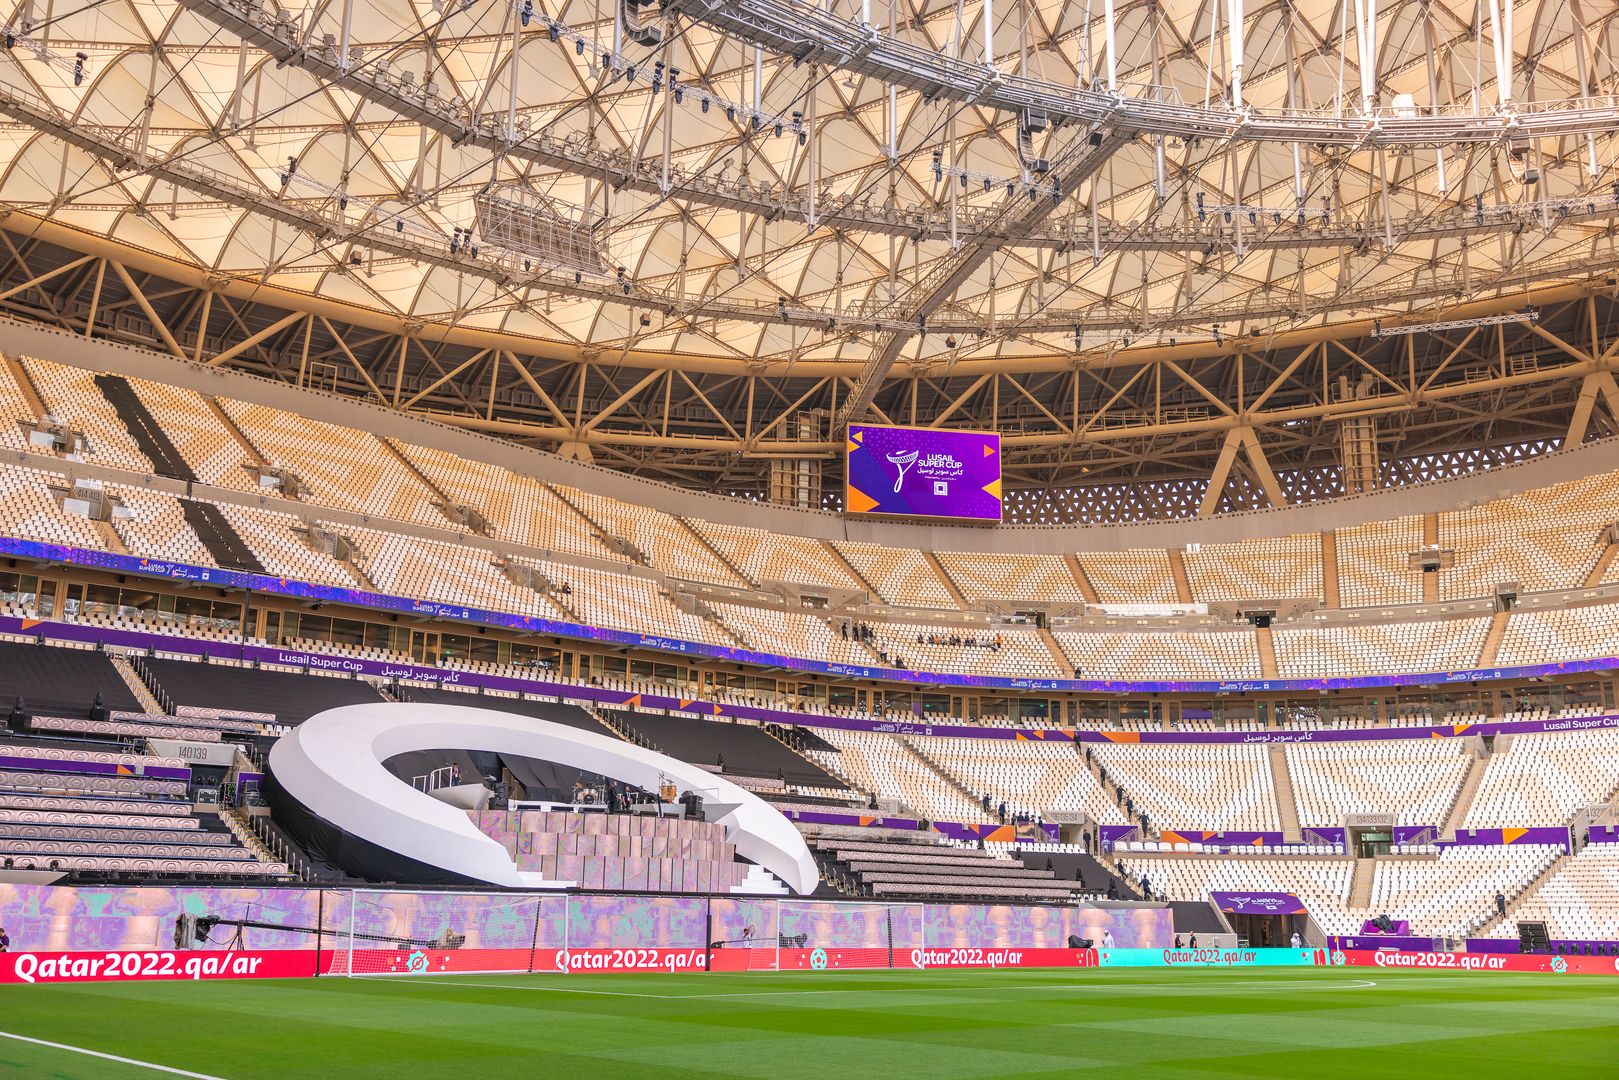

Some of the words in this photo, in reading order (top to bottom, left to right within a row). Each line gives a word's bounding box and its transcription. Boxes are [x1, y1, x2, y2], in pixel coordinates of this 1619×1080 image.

[918, 459, 945, 468] SUPER
[945, 460, 963, 469] CUP
[927, 453, 955, 462] LUSAIL
[279, 652, 309, 665] Lusail
[310, 656, 342, 670] Super
[343, 660, 363, 673] Cup
[381, 665, 413, 679] لوسيل
[413, 671, 438, 682] سوبر
[1543, 721, 1571, 731] Lusail
[1572, 719, 1602, 729] Super
[1243, 733, 1270, 743] لوسيل
[1271, 735, 1293, 743] سوبر
[1294, 732, 1313, 742] كأس
[178, 746, 192, 759] 140
[193, 747, 208, 760] 139
[911, 948, 1022, 968] Qatar2022.qa/ar
[1163, 949, 1257, 965] Qatar2022.qa/ar
[1374, 950, 1507, 970] Qatar2022.qa/ar
[14, 952, 263, 983] Qatar2022.qa/ar
